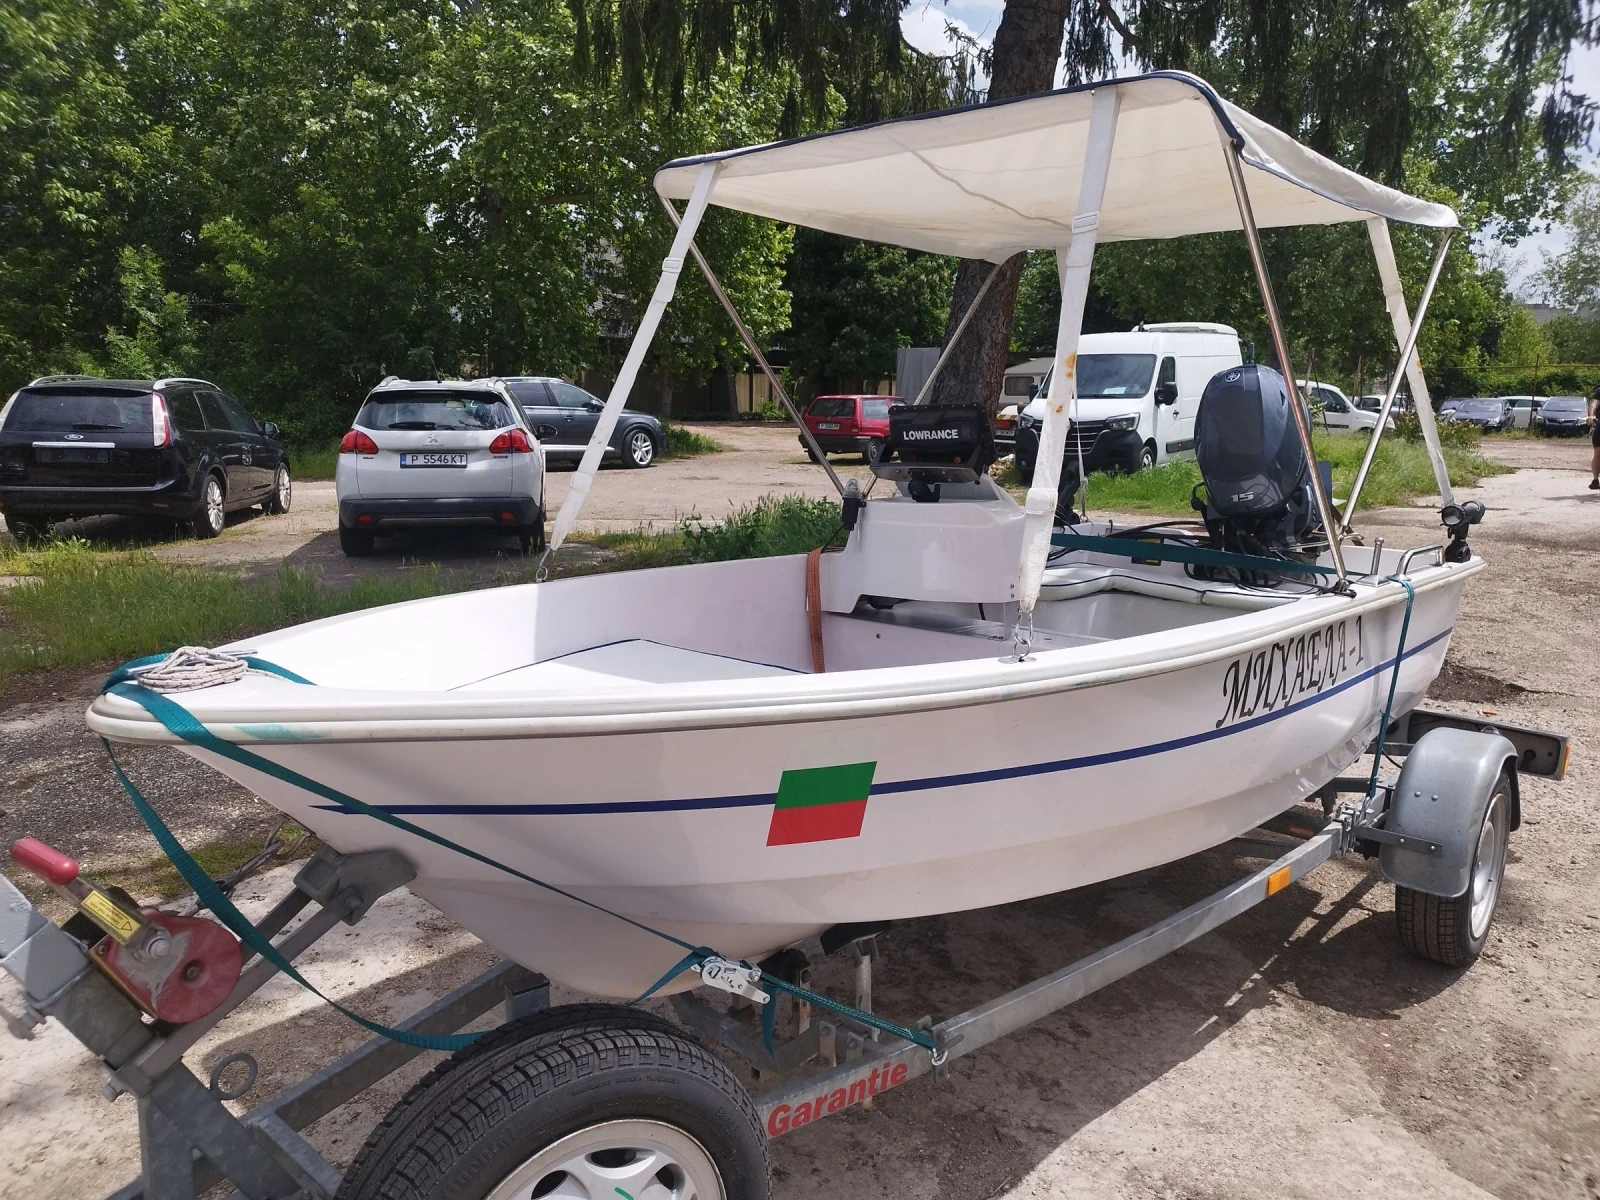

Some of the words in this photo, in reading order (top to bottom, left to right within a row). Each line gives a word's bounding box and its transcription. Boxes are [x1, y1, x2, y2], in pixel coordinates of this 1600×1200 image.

[903, 429, 959, 440] LOWRANCE
[1231, 491, 1254, 502] 15
[1215, 615, 1364, 729] МИХАЕЛА-1
[767, 1062, 908, 1137] Garantie
